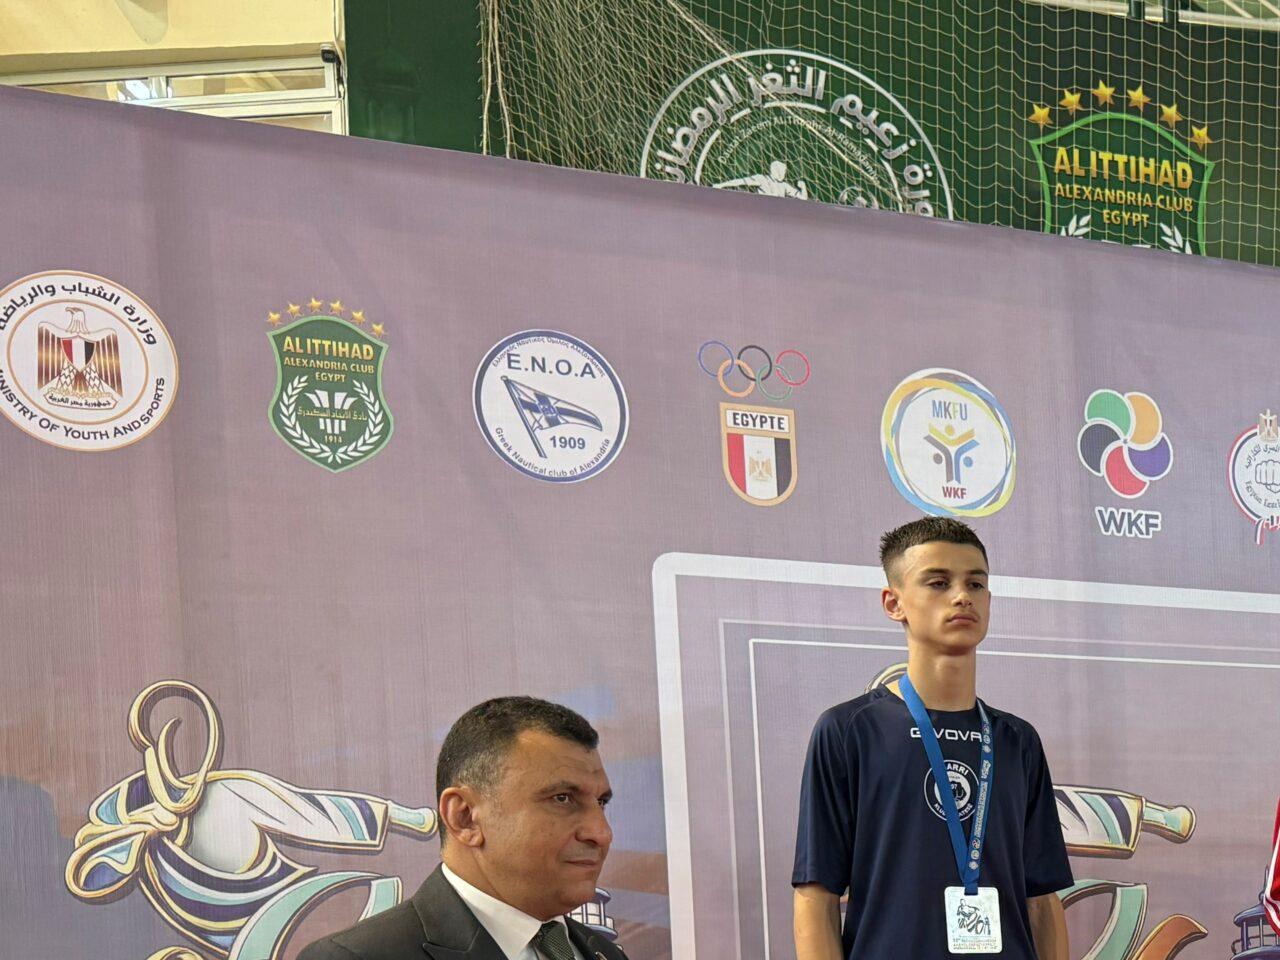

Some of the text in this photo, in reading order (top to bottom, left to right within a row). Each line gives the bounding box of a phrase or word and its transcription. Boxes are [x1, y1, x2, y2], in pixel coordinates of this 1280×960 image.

[748, 58, 827, 108] الثغر
[657, 73, 742, 184] الرمضان
[1055, 182, 1194, 213] ALEXANDRIA CLUB
[1102, 209, 1150, 228] EGYPT
[61, 282, 121, 306] الشباب
[123, 304, 157, 346] وزارة
[284, 357, 375, 374] ALEXANDRIA CLUB
[315, 371, 346, 383] EGYPT
[506, 353, 597, 379] E.N.O.A
[731, 411, 786, 432] EGYPTE
[931, 399, 969, 422] MKFU
[38, 417, 60, 433] OF
[63, 425, 109, 441] YOUTH
[324, 434, 343, 444] 1914
[495, 427, 611, 477] Greek Nautical club of Alexandria
[549, 435, 586, 450] 1909
[941, 485, 968, 500] WKF
[1097, 508, 1161, 537] WKF
[910, 727, 982, 743] GVOVA
